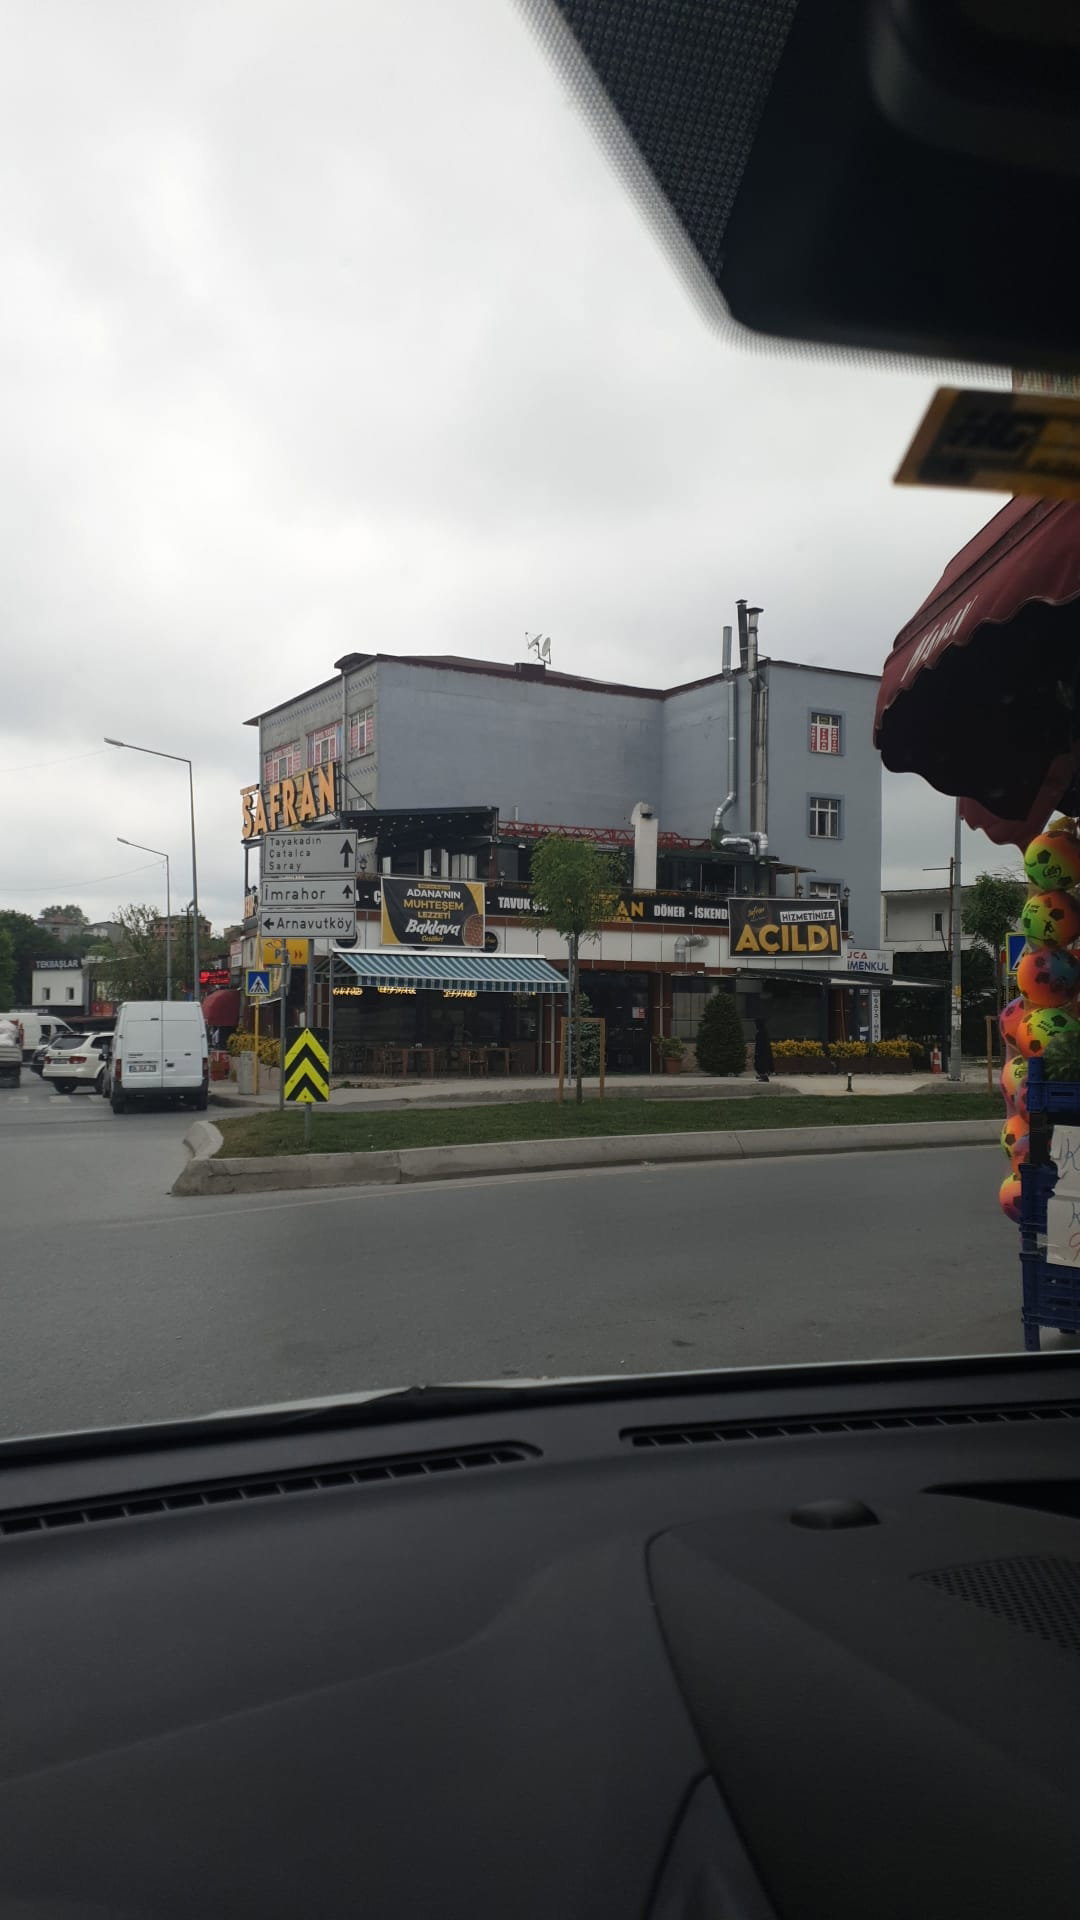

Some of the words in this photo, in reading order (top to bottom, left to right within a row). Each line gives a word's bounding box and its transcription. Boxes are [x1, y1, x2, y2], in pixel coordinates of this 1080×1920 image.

[242, 761, 337, 839] SAFRAN
[269, 861, 301, 872] Saray
[265, 884, 326, 900] İmrahor
[403, 899, 464, 911] MUHTEŞEM
[498, 897, 530, 910] TAVUK
[417, 911, 450, 920] LEZZETİ
[654, 904, 685, 918] DÖNER
[277, 917, 352, 932] Arnavutköy
[405, 919, 461, 936] Baklava
[735, 923, 838, 955] AÇILDI
